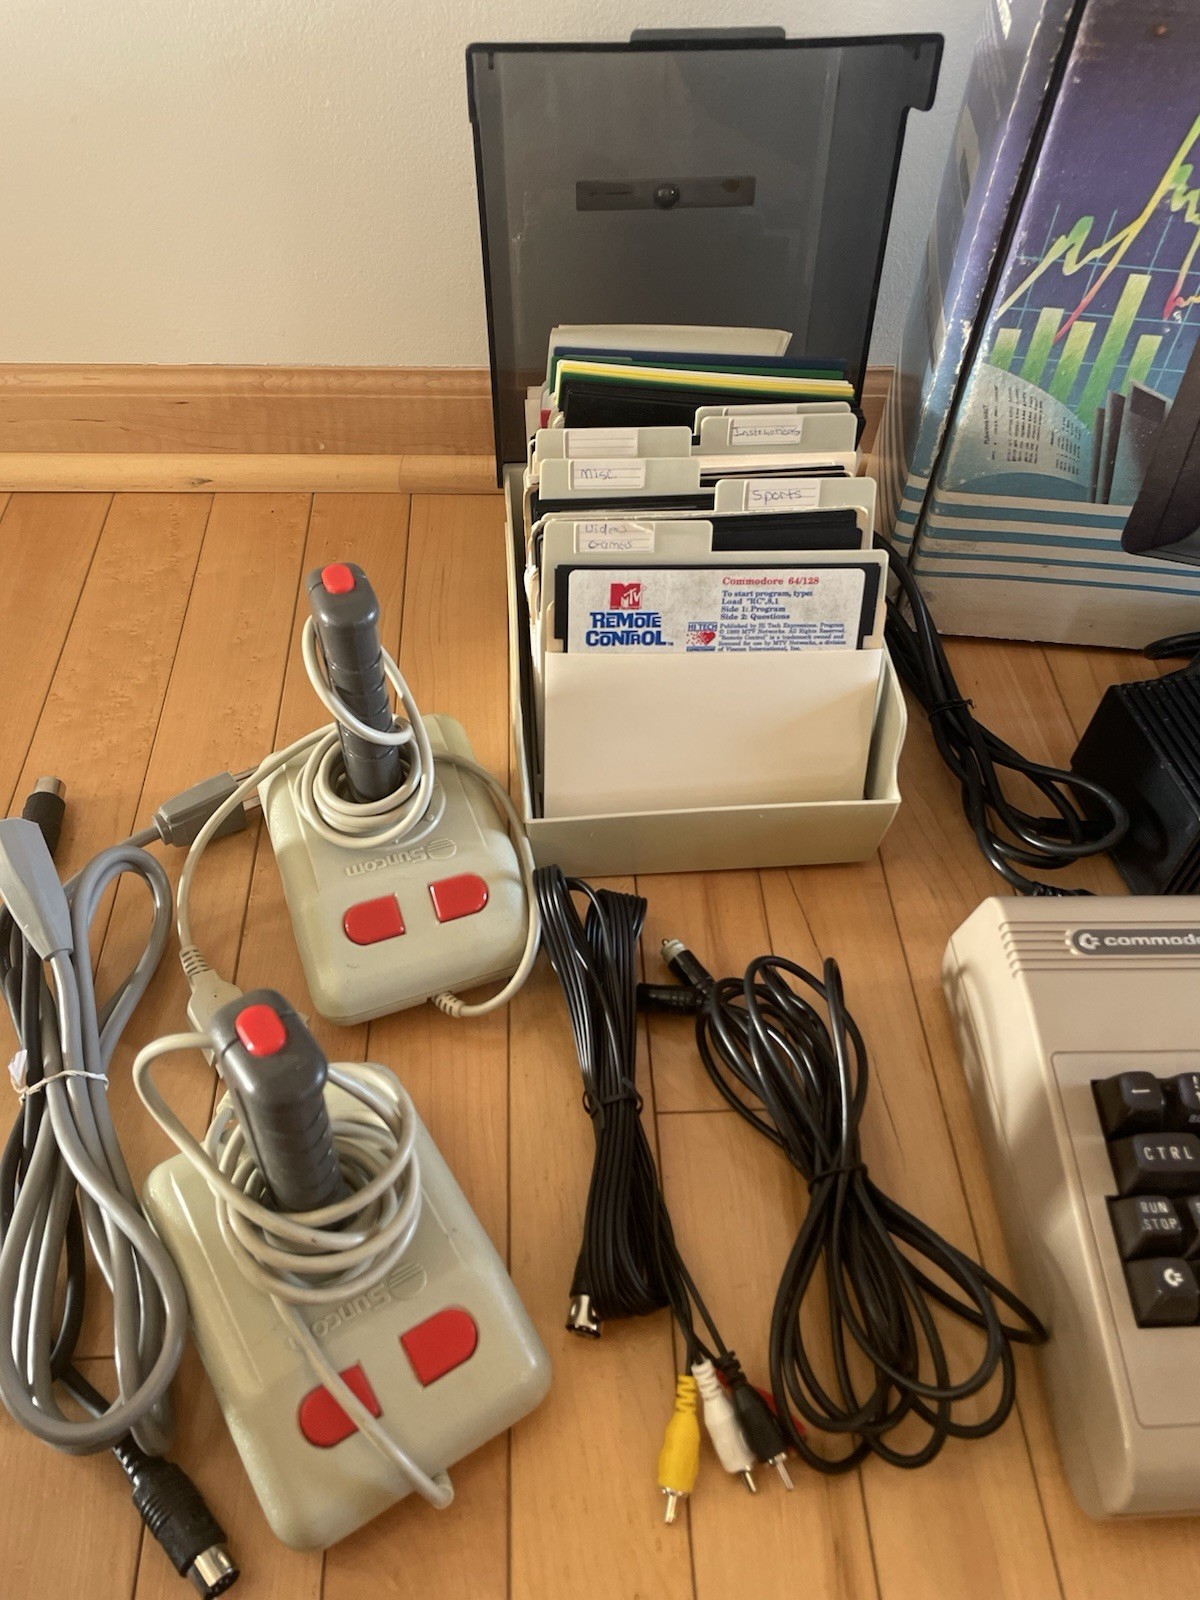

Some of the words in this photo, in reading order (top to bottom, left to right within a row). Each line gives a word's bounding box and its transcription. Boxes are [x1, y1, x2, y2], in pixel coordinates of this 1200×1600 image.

[752, 489, 802, 506] Sports
[585, 523, 627, 535] Video
[722, 577, 784, 586] Commodore
[788, 576, 820, 585] 64/128
[609, 583, 645, 608] MTV
[755, 590, 791, 599] program,
[751, 606, 786, 614] Program
[345, 846, 427, 876] Suncom
[1143, 1146, 1194, 1161] CTRL
[1140, 1201, 1169, 1213] RUN
[1142, 1218, 1177, 1230] STOP
[310, 1282, 392, 1338] Sunco
